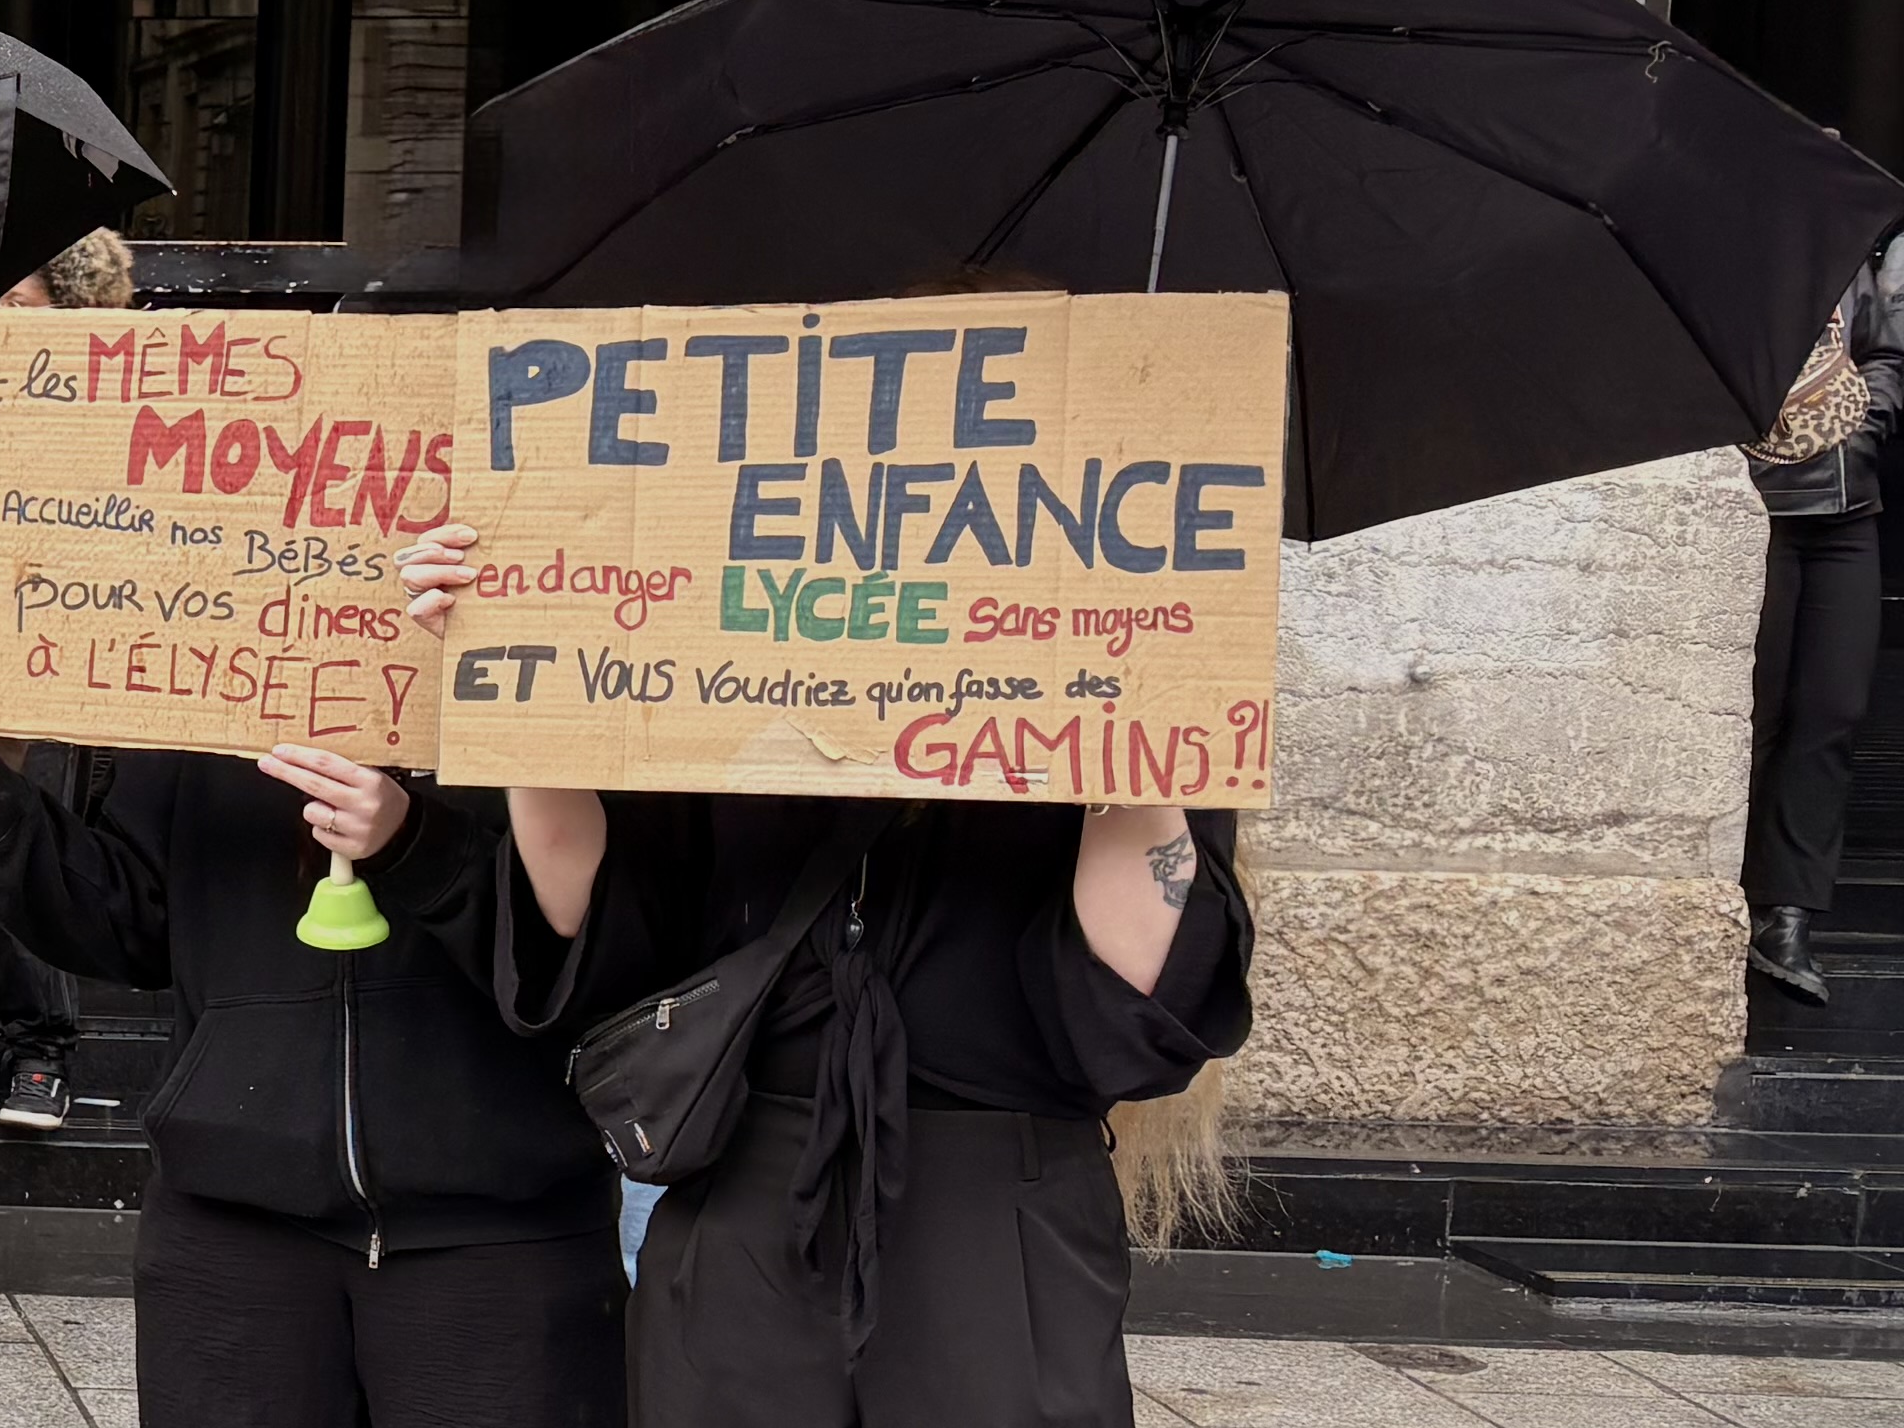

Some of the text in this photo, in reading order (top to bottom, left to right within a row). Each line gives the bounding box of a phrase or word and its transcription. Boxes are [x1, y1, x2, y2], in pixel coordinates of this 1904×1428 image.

[20, 347, 79, 404] les
[86, 320, 304, 404] MÊMES
[126, 404, 455, 538] MOYENS
[170, 519, 224, 548] nos
[727, 458, 1267, 573] ENFANCE
[476, 563, 529, 599] en
[544, 548, 692, 632] danger
[720, 565, 950, 644] LYCÉE
[1071, 600, 1195, 657] moyens
[26, 632, 61, 679] à
[453, 645, 557, 703] ET
[865, 670, 945, 723] qu'on
[944, 667, 1044, 718] fasse
[1064, 668, 1122, 699] des
